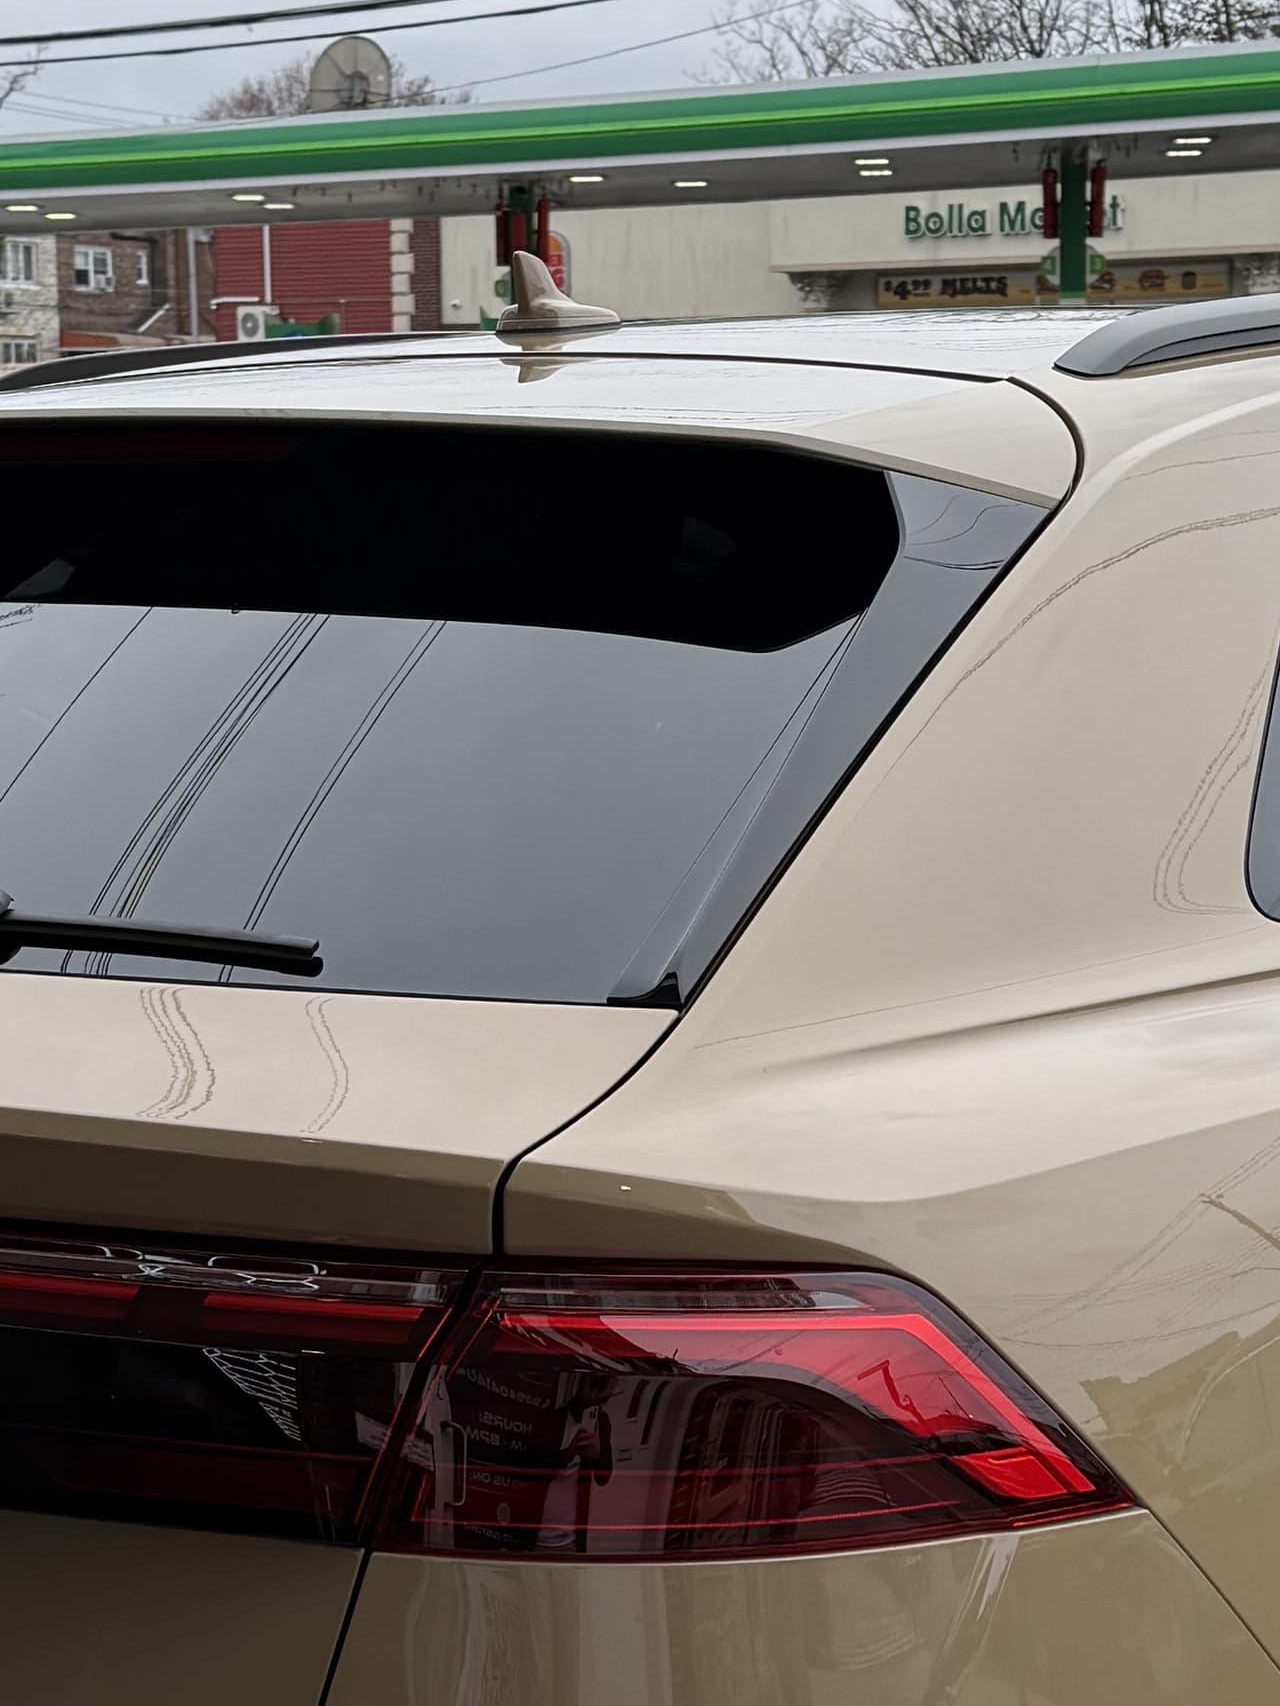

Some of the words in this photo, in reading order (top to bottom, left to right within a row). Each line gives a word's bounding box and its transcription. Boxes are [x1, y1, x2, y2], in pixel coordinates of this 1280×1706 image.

[904, 203, 987, 237] Bolla
[999, 195, 1122, 234] Mat
[939, 276, 1009, 298] MELTS
